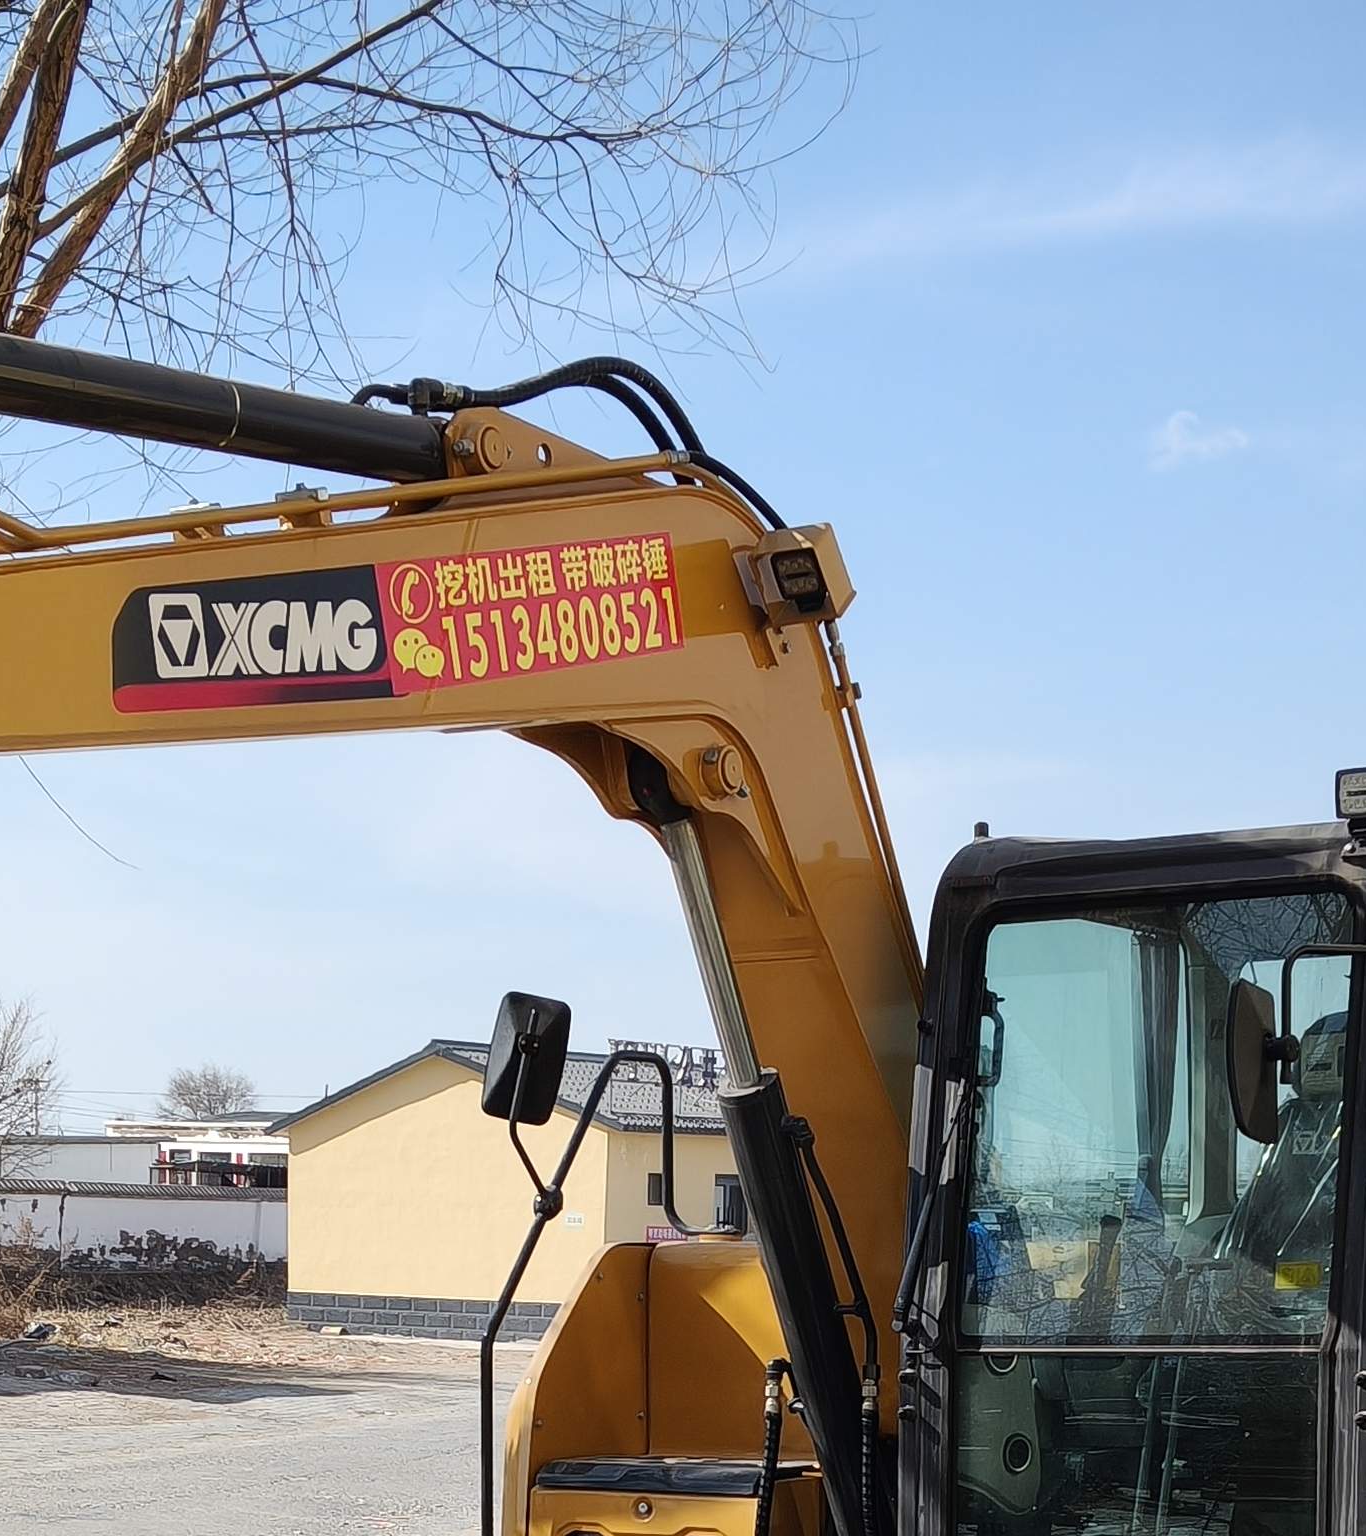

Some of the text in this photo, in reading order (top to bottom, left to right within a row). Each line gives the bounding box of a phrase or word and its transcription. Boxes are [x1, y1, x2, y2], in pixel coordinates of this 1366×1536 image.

[434, 537, 669, 610] 挖机出租 带破碎锤
[210, 599, 378, 676] XCMG
[441, 586, 678, 680] 15134808521
